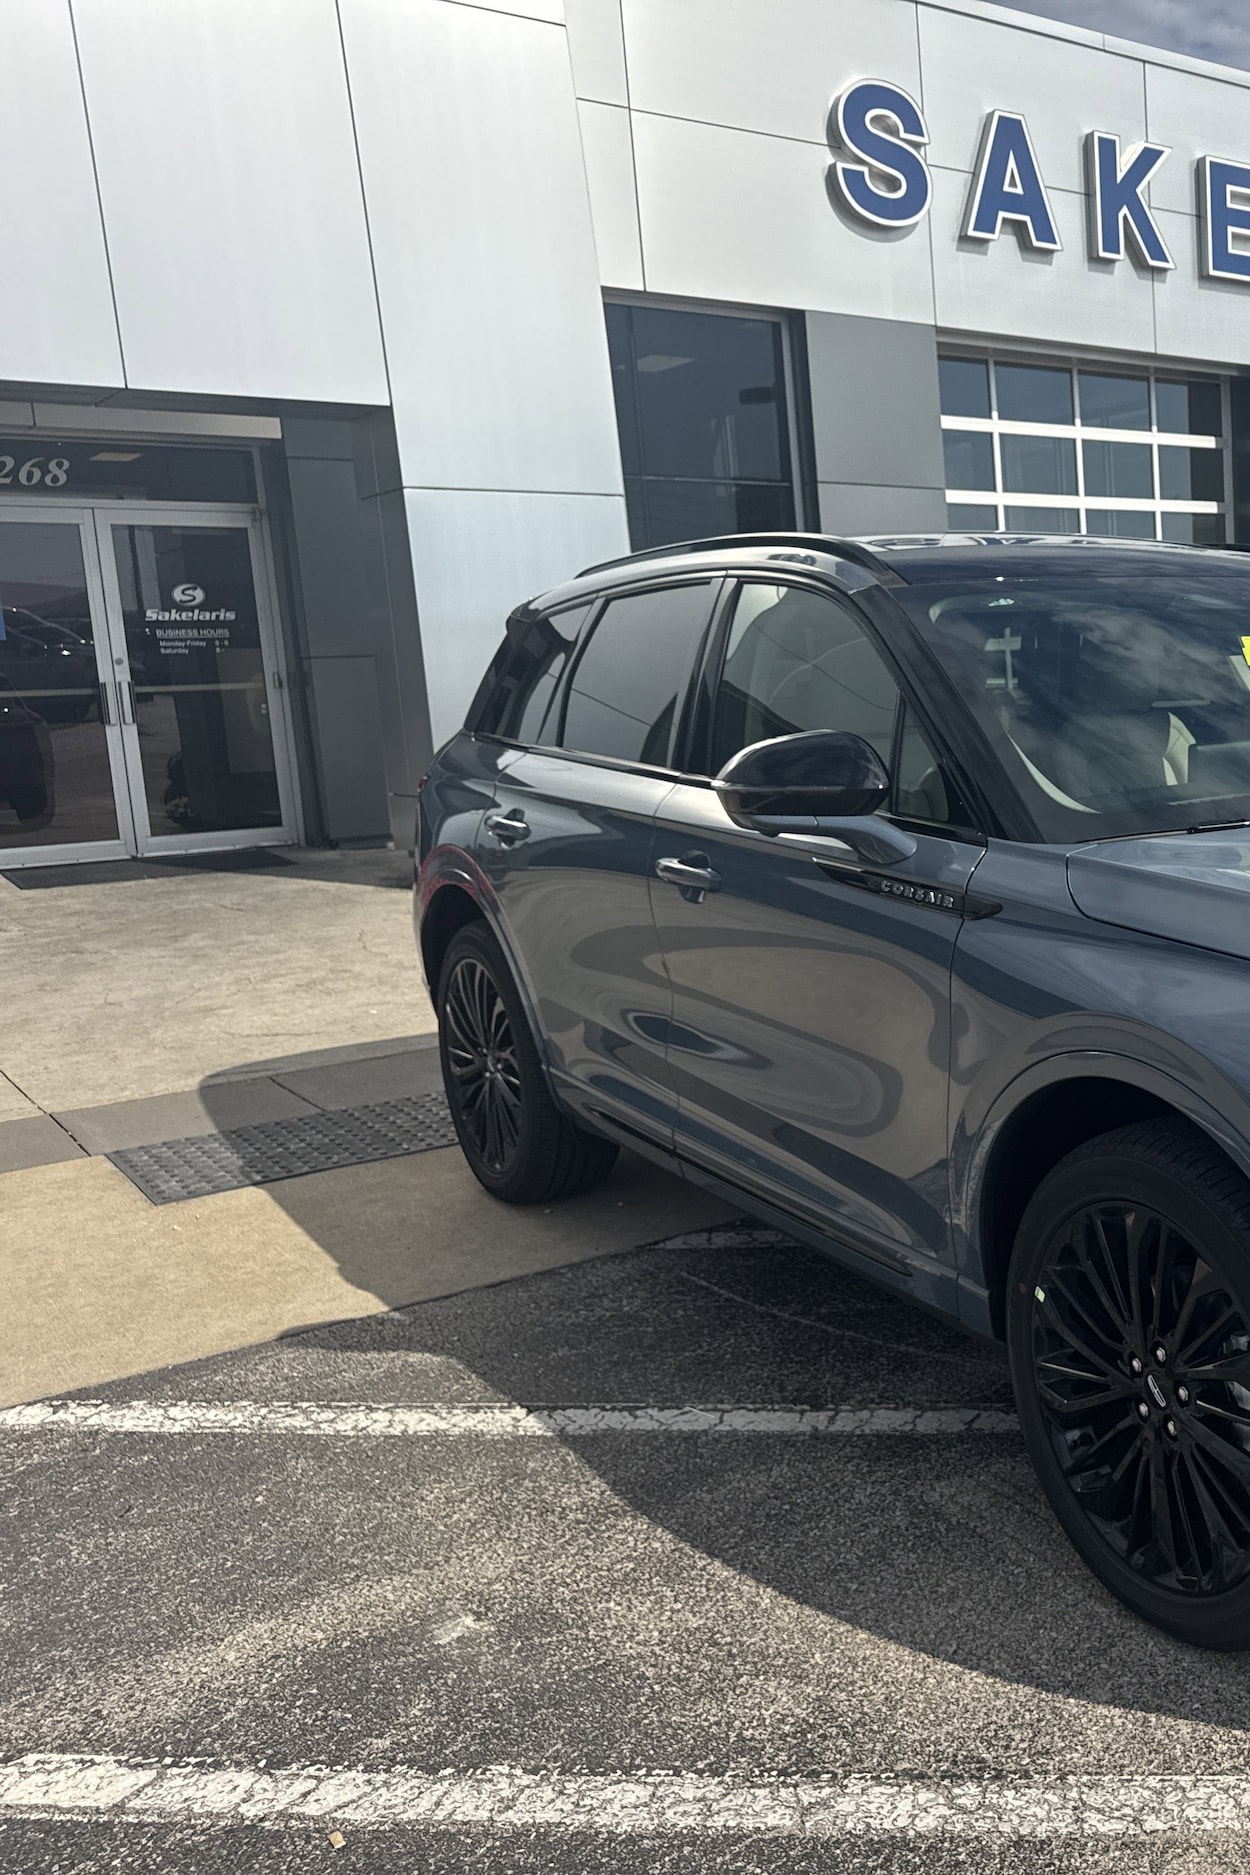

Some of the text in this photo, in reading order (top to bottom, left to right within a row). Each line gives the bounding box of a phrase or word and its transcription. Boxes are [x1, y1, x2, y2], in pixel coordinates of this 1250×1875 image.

[145, 608, 236, 621] Sakelaris
[155, 628, 229, 637] BUSINESS HOURS
[880, 880, 954, 908] CORSAIR
